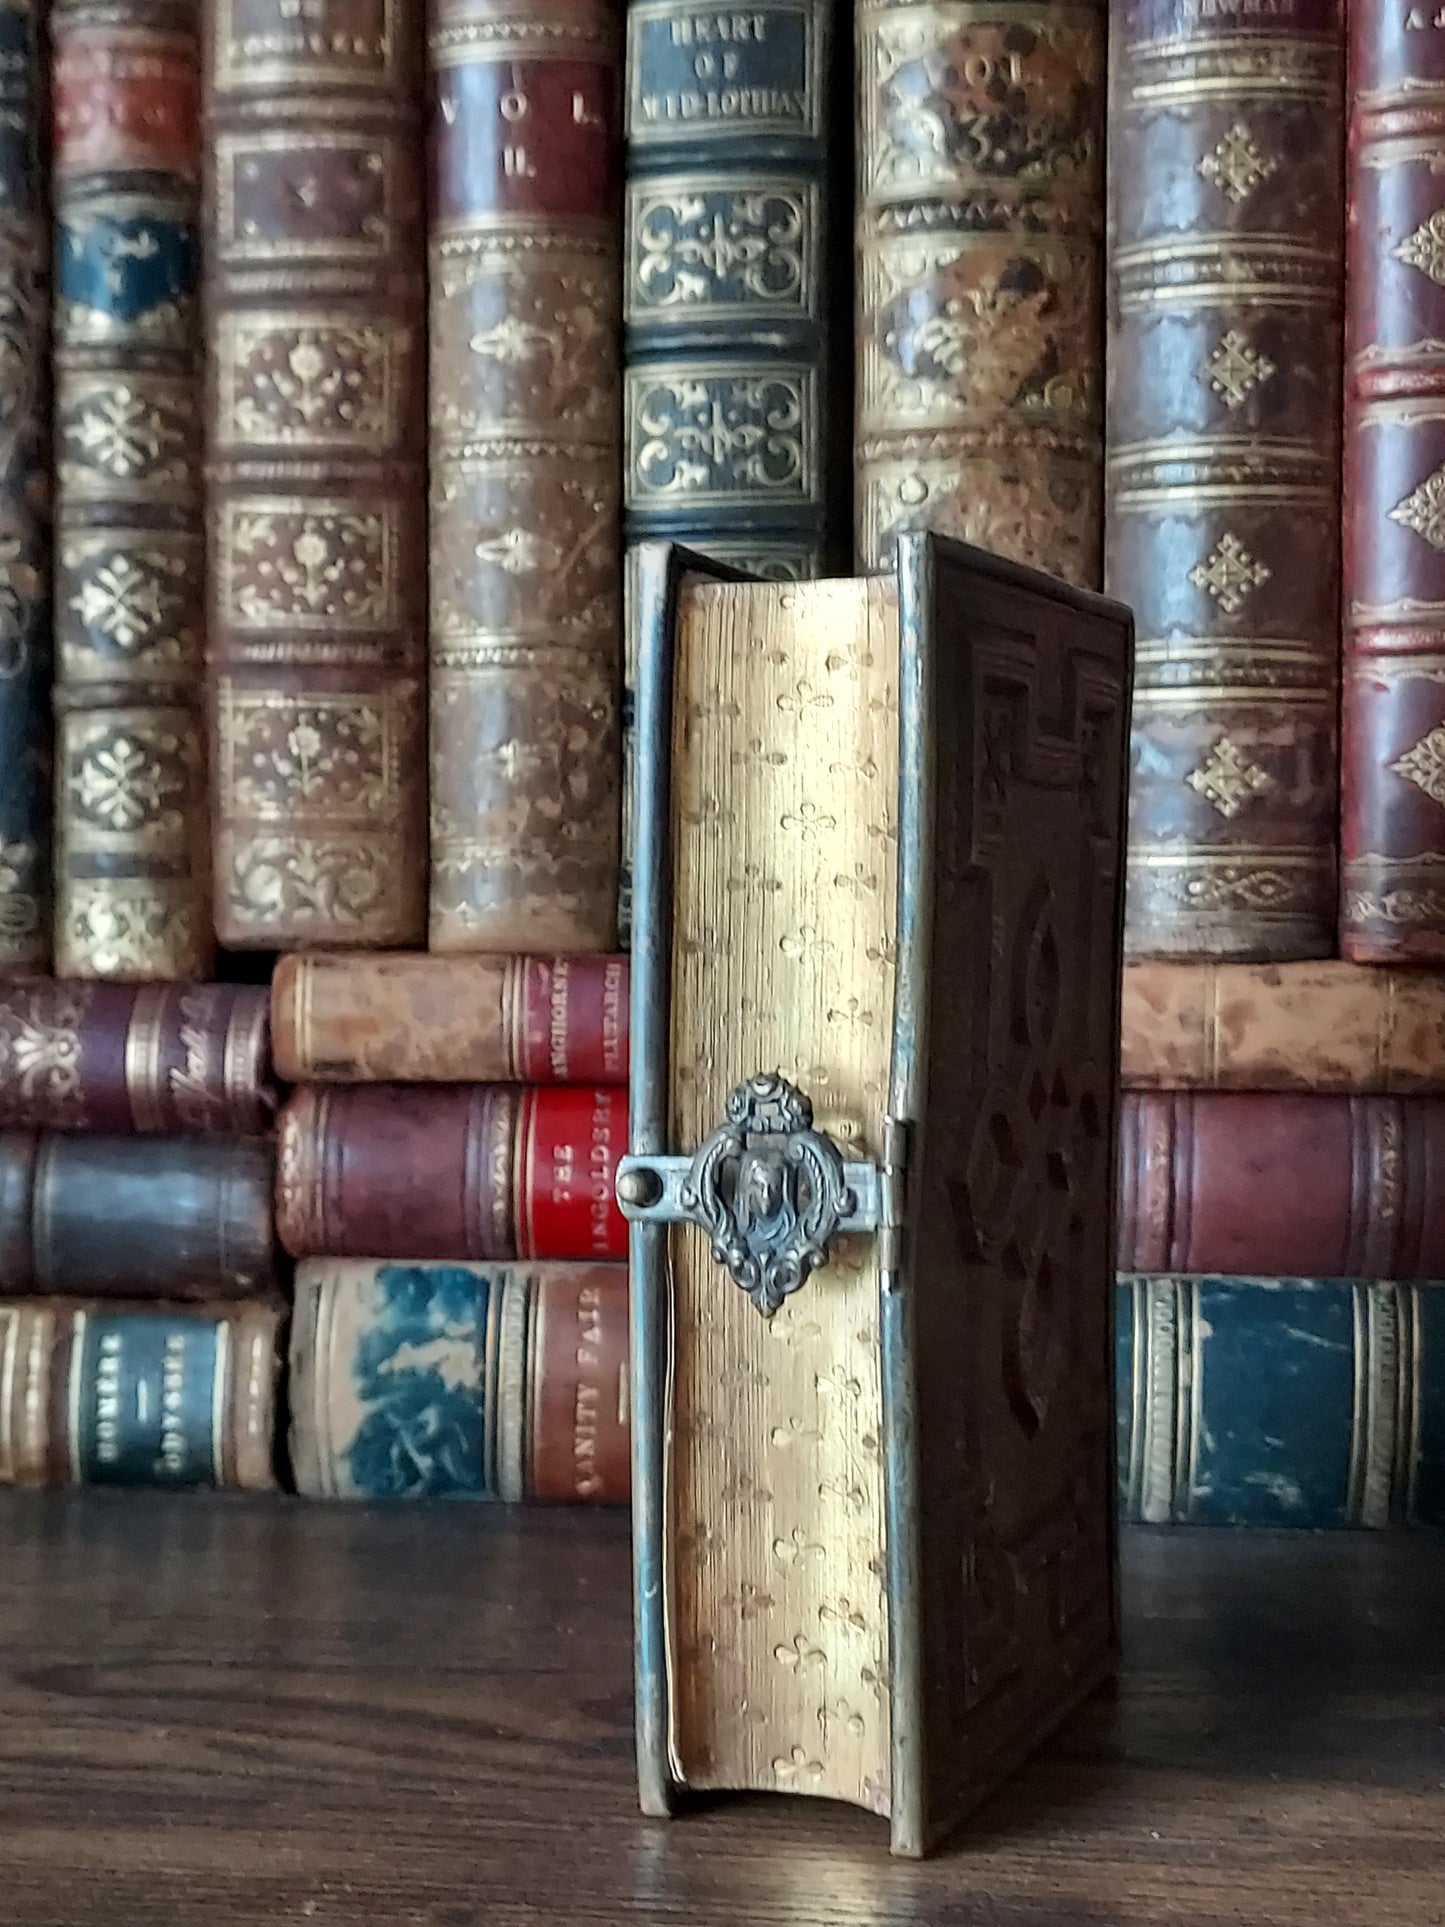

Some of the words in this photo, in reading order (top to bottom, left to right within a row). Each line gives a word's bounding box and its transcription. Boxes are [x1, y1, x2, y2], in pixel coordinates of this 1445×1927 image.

[695, 51, 738, 80] OF
[553, 1143, 574, 1205] THE
[577, 1287, 601, 1365] FAIR
